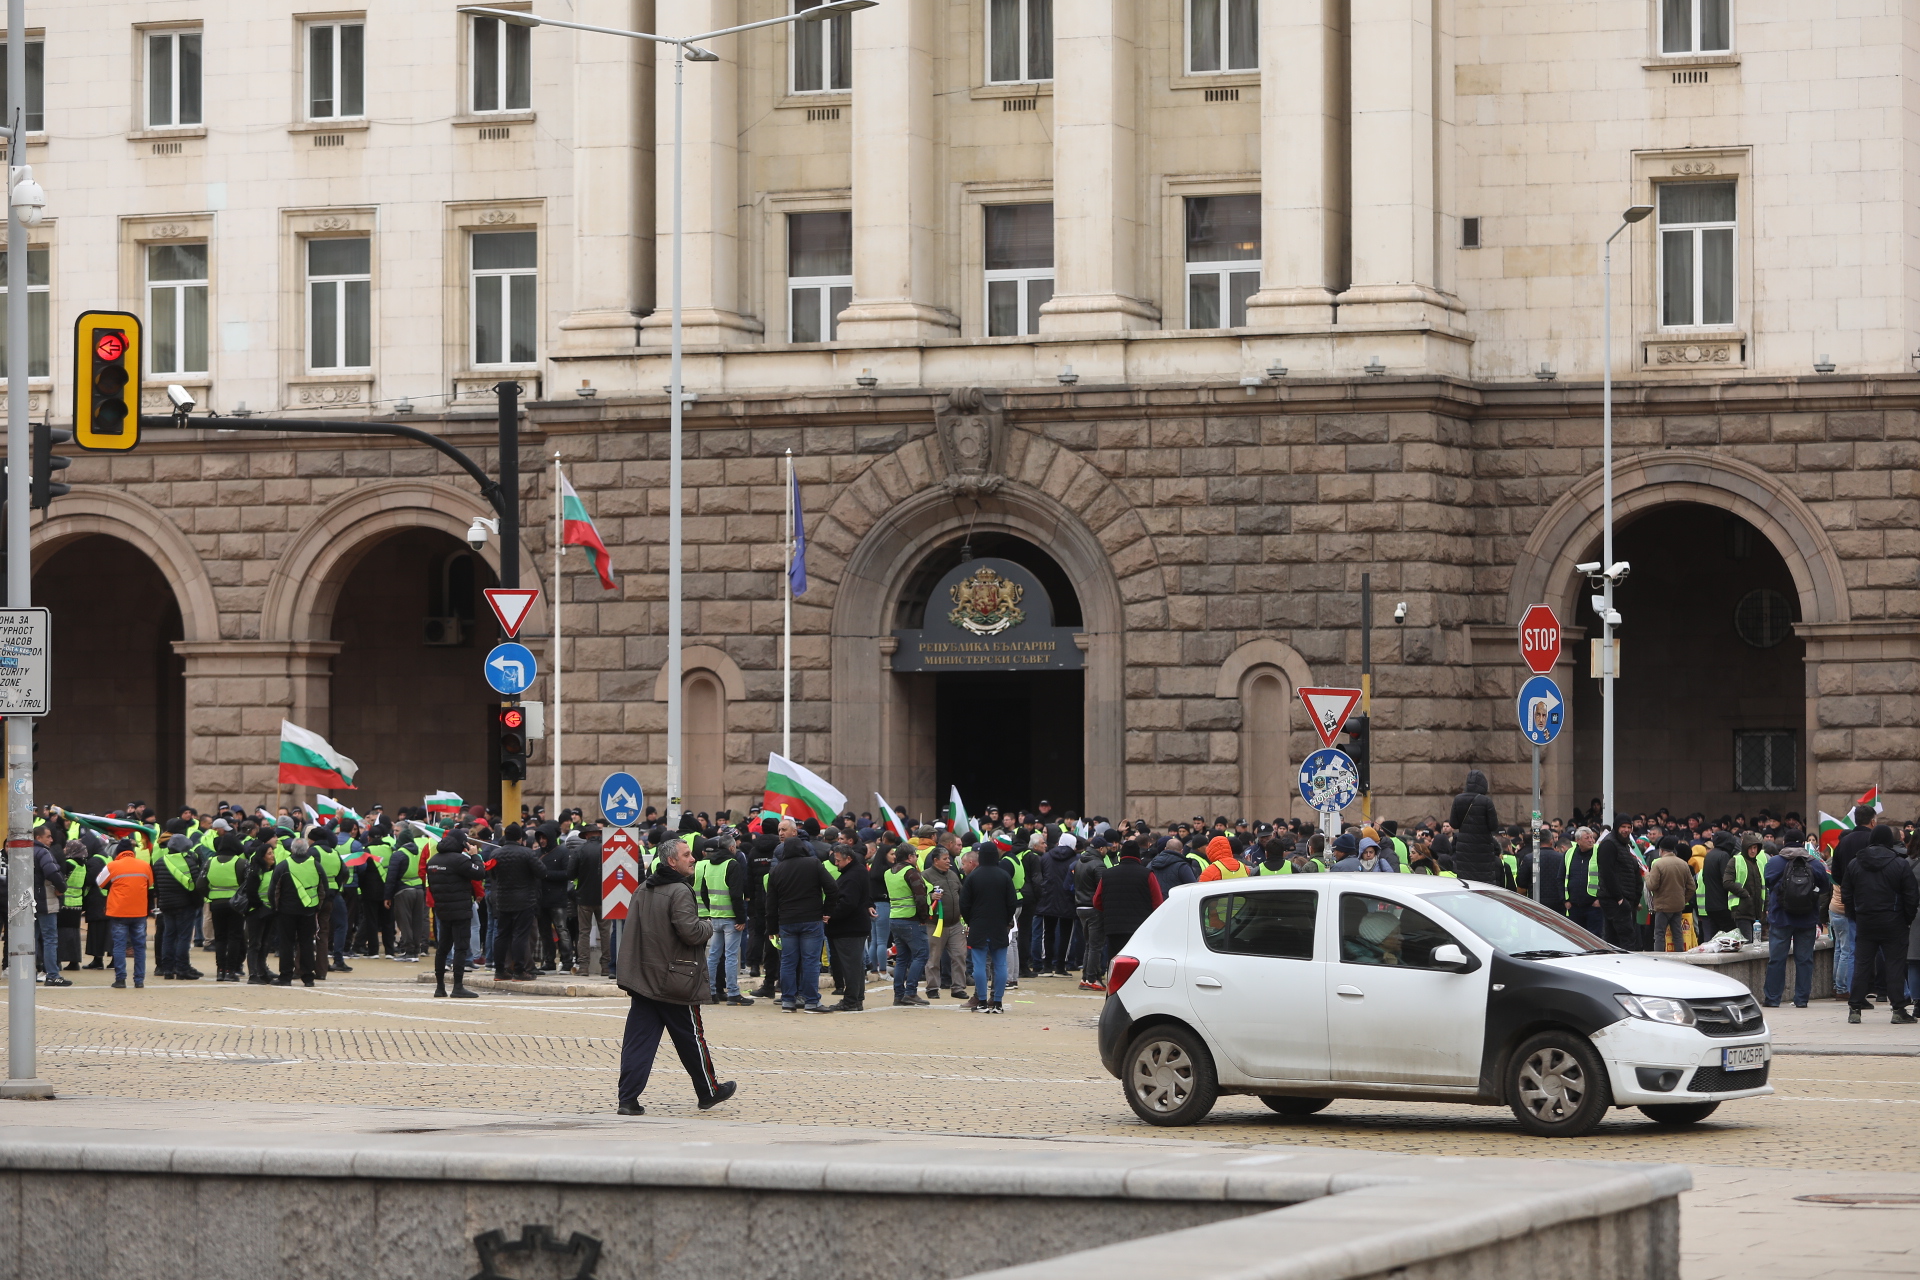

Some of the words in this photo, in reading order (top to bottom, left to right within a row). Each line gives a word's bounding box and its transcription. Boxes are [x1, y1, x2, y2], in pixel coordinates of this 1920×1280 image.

[18, 615, 29, 625] ЗА
[1525, 628, 1557, 651] STOP
[918, 642, 990, 653] РЕПУБЛИКА
[993, 641, 1057, 651] БЪЛГАРИЯ
[924, 655, 1010, 665] МИНИСТЕРСКИ
[1012, 654, 1051, 664] СЪВЕТ
[0, 678, 21, 687] ZONE
[1739, 1049, 1754, 1064] 0425
